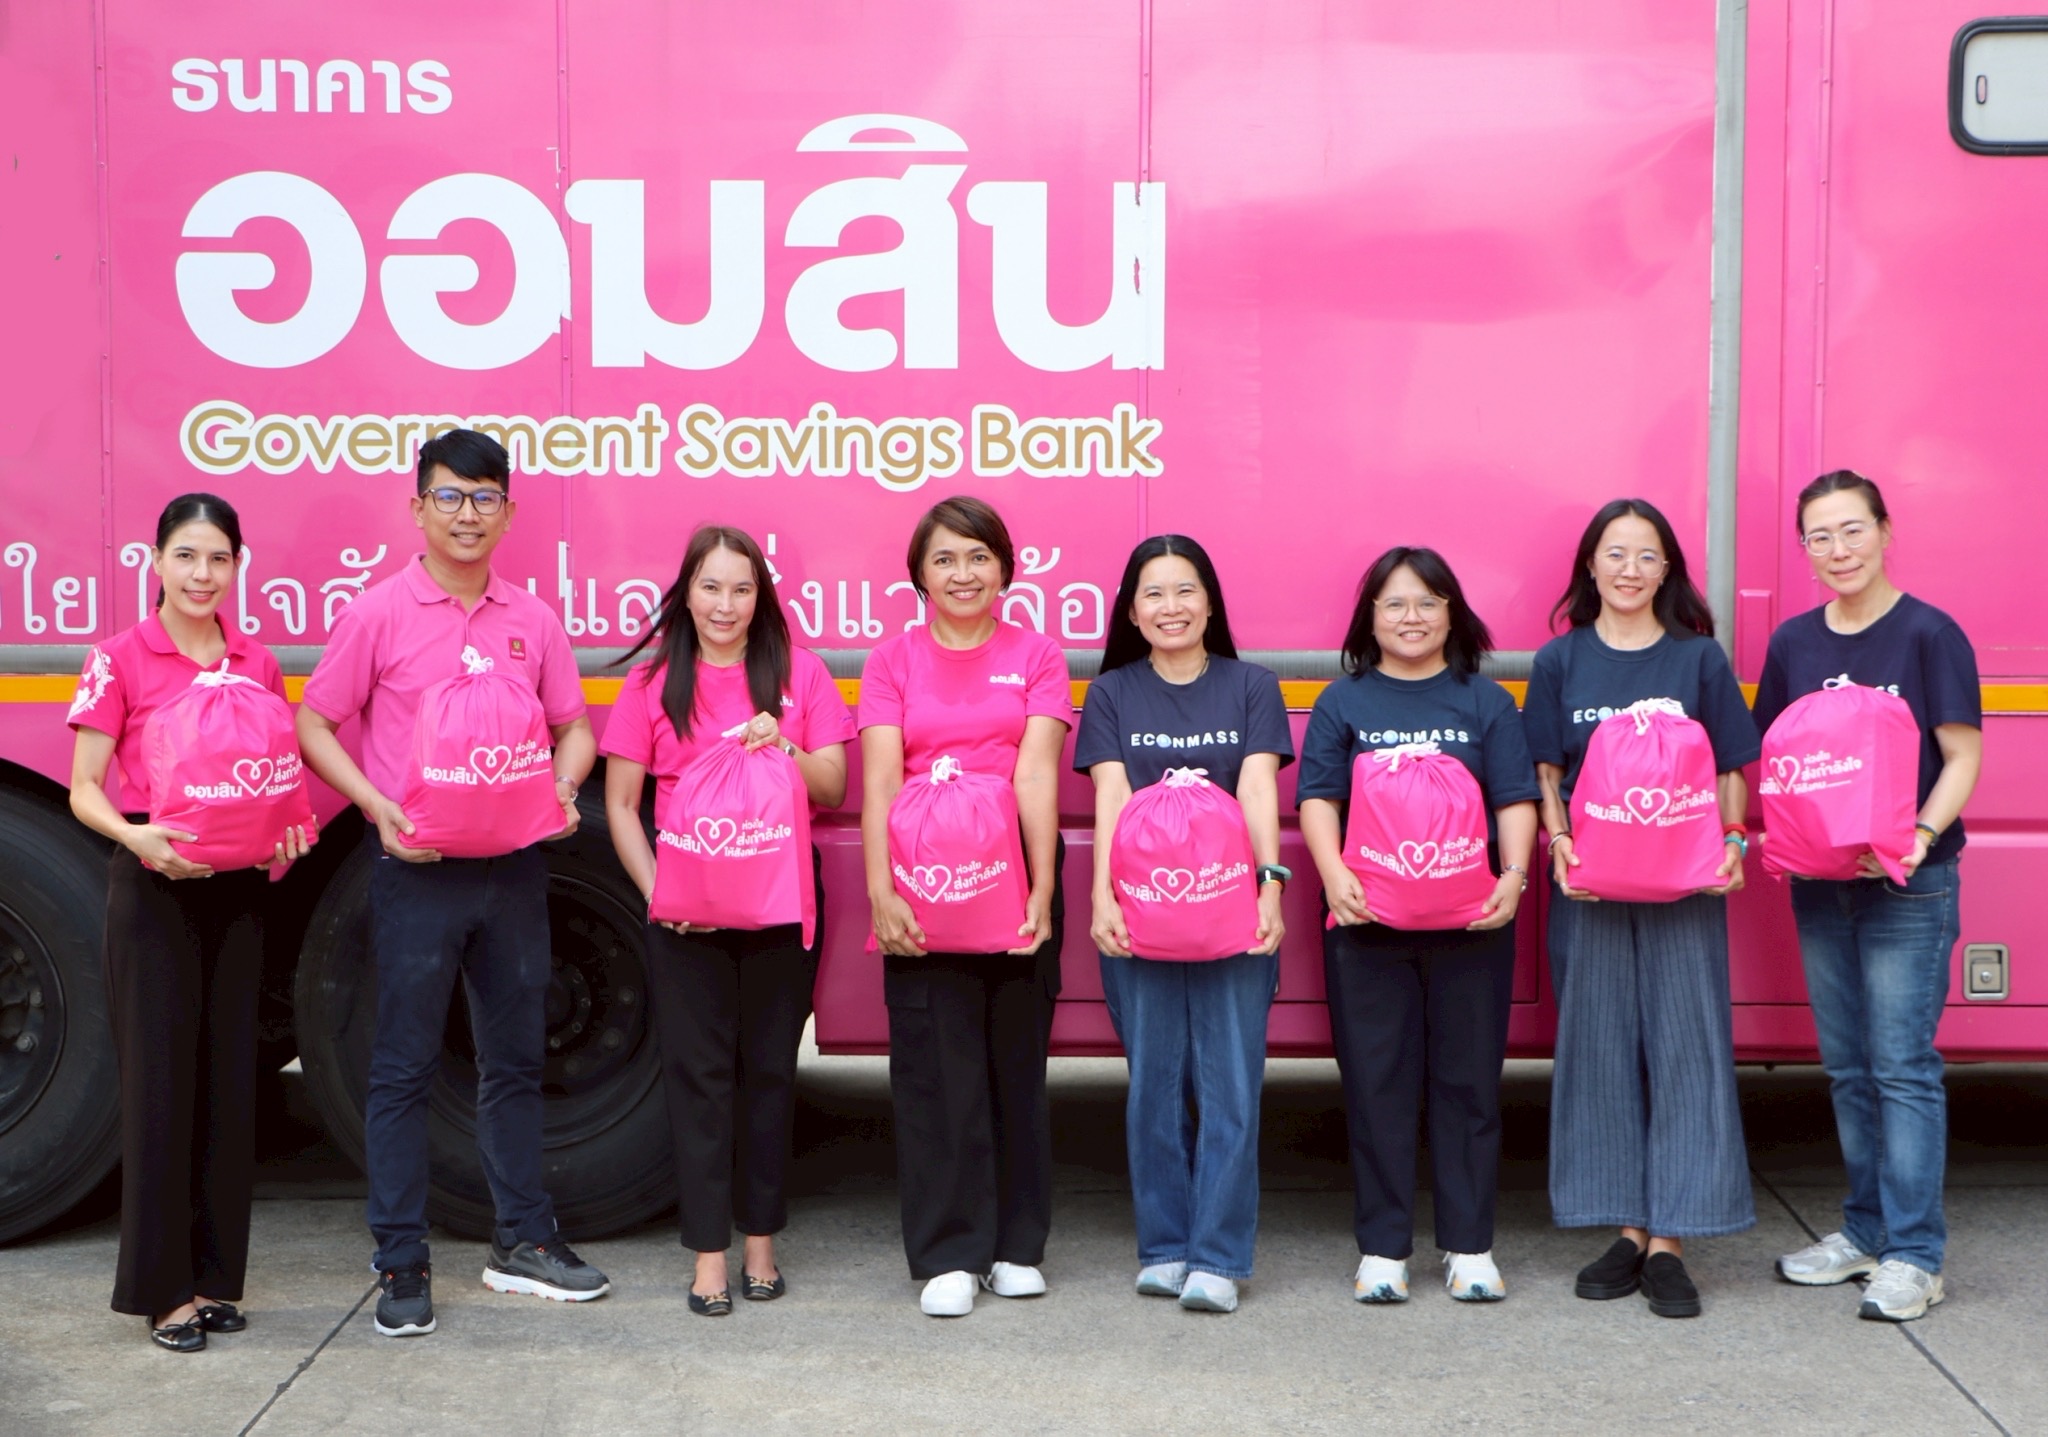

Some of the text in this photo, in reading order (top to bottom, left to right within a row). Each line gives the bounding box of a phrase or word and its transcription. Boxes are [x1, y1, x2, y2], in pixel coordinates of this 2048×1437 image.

[172, 57, 453, 114] ธนาคาร
[175, 113, 1165, 372] ออมสิน
[681, 408, 957, 487] Savings
[978, 409, 1161, 472] Bank
[1131, 730, 1239, 748] ECONMASS
[1360, 728, 1469, 744] ECONMASS
[423, 766, 477, 785] ออมสิน
[1801, 756, 1863, 781] ส่งกำลังใจ
[184, 782, 242, 798] ออมสิน
[1584, 801, 1632, 824] ออมสิน
[659, 829, 701, 854] ออมสิน
[736, 824, 791, 846] ส่งกำลังใจ
[955, 860, 982, 875] ห่วงใย
[1360, 845, 1406, 876] ออมสิน
[953, 860, 1007, 890] ส่งกำลังใจ
[1196, 862, 1249, 892] ส่งกำลังใจ
